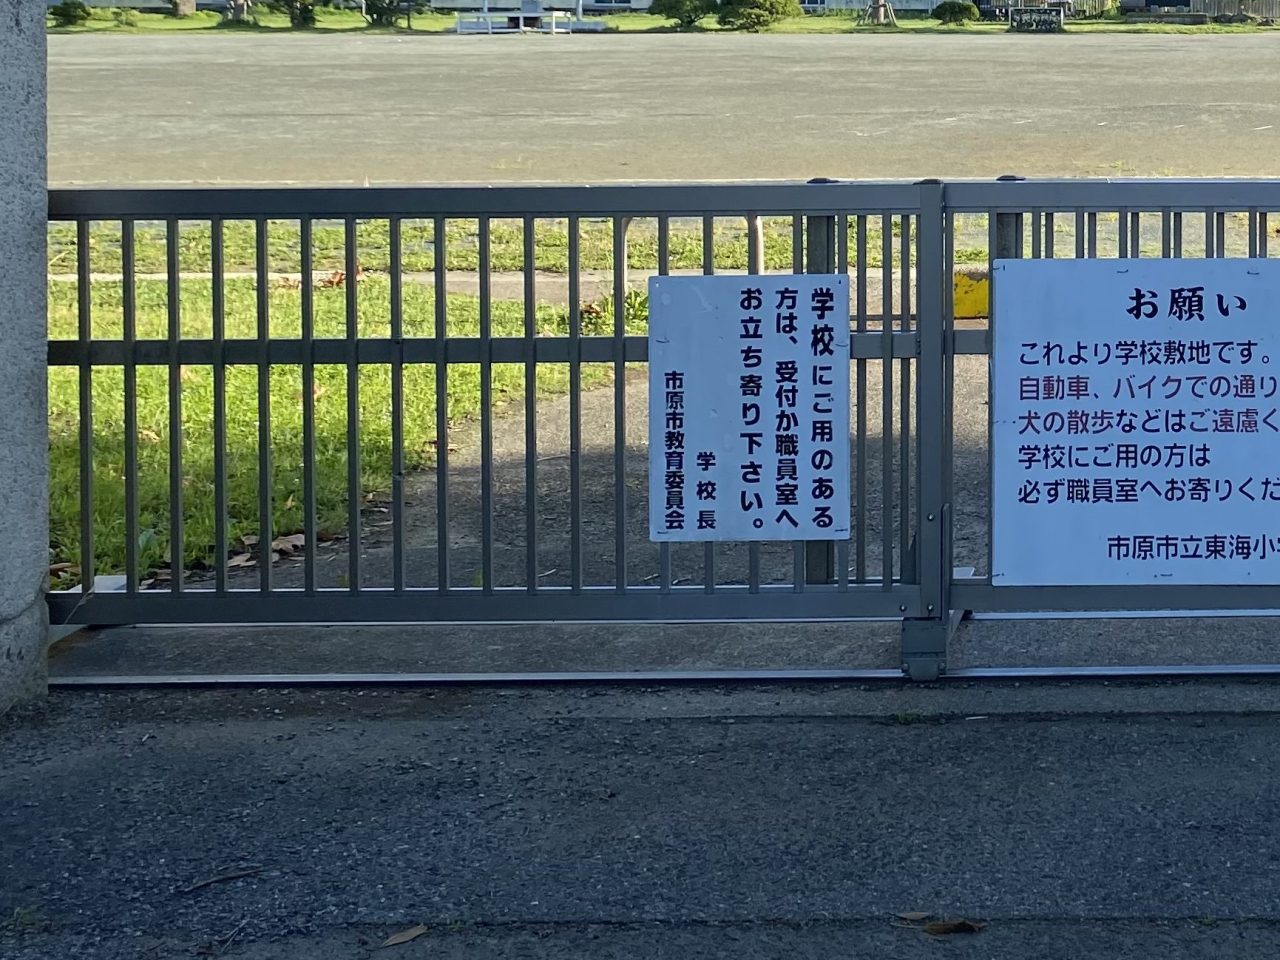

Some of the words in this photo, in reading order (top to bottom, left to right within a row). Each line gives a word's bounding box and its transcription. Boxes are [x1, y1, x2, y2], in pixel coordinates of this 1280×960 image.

[1019, 340, 1271, 366] これより学校敷地です。
[1126, 286, 1247, 322] お願い
[664, 370, 685, 530] 市原市教育委員会
[739, 287, 764, 529] お立ち寄り下さい。
[775, 287, 799, 528] 方は、受付か職員室へ
[810, 287, 834, 528] 学校にご用のある
[1018, 443, 1211, 469] 学校にご用の方は
[696, 451, 717, 530] 学校長
